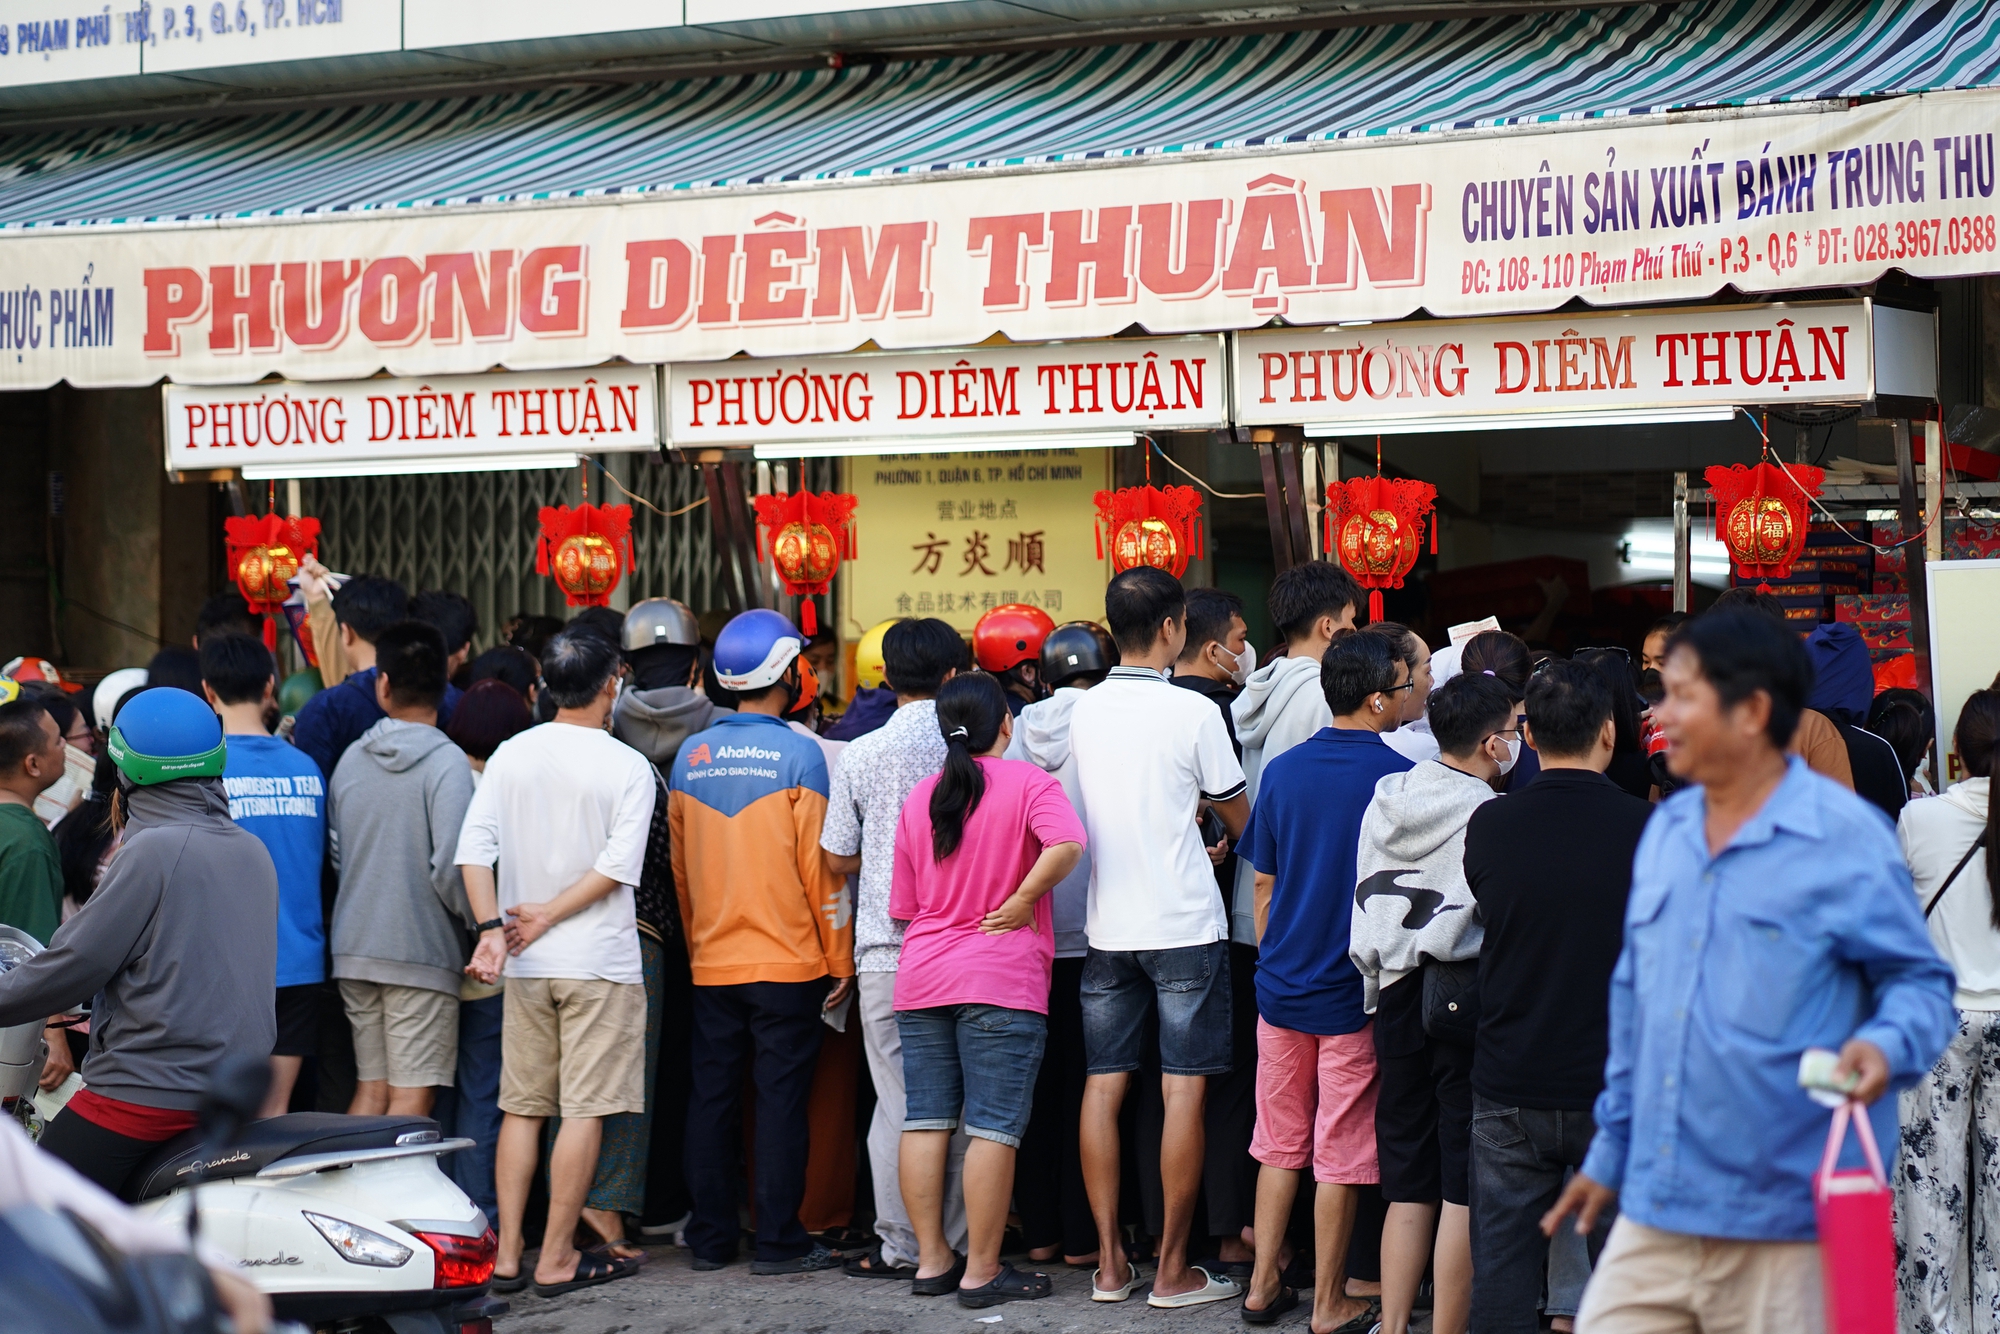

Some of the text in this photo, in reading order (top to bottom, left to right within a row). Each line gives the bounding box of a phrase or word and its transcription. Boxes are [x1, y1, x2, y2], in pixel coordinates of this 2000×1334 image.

[17, 19, 69, 61] PHẠM
[76, 5, 111, 48] PHÚ
[1462, 133, 1995, 243] CHUYÊN SẢN XUẤT BÁNH TRUNG THU
[143, 173, 1433, 359] PHƯƠNG DIÊM THUẬN
[1462, 259, 1490, 294] ĐC:
[1580, 251, 1627, 292] Phạm
[1631, 246, 1665, 281] Phú
[1671, 241, 1704, 278] Thứ
[1721, 235, 1750, 274] P.3
[1768, 231, 1797, 276] Q.6
[1818, 227, 1848, 265] ĐT:
[1854, 214, 1996, 263] 028.3967.0388
[50, 261, 114, 348] PHẨM
[1257, 318, 1849, 402] PHƯƠNG DIÊM THUẬN
[689, 351, 1206, 427] PHƯƠNG DIÊM THUẬN
[185, 378, 639, 449] PHƯƠNG DIÊM THUẬN
[1050, 465, 1082, 481] MINH
[936, 499, 1019, 521] 营业地点
[1345, 534, 1358, 550] 福
[1375, 526, 1387, 559] 大吉大利
[1736, 513, 1747, 548] 大吉大利
[1762, 522, 1784, 539] 福
[912, 530, 1046, 577] 方炎順
[1120, 541, 1136, 558] 福
[1152, 533, 1164, 565] 大吉大利
[896, 590, 1063, 613] 食品技术有限公司
[716, 745, 781, 761] AhaMove
[707, 767, 727, 778] CAO
[728, 767, 748, 776] GIAO
[749, 766, 777, 779] HÀNG
[191, 1150, 251, 1174] Grande
